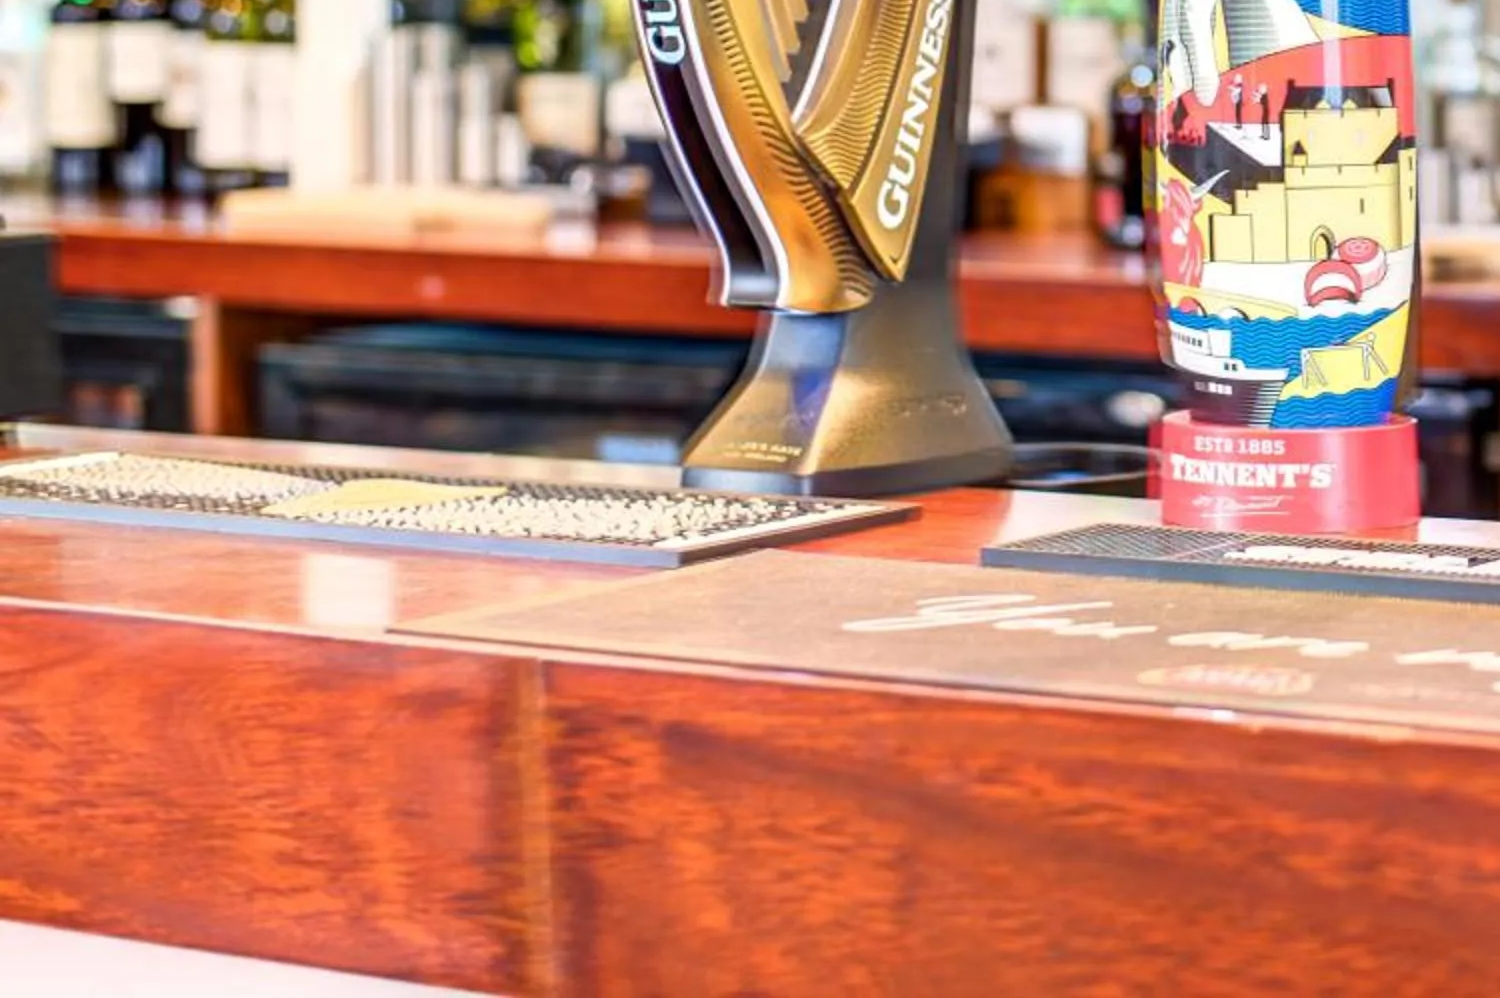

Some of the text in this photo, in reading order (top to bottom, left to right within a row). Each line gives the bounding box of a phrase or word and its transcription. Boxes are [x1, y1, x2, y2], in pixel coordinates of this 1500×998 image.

[1238, 439, 1286, 455] 1885
[1170, 454, 1337, 489] TENNENT'S
[843, 594, 1156, 636] You
[1168, 631, 1368, 658] are
